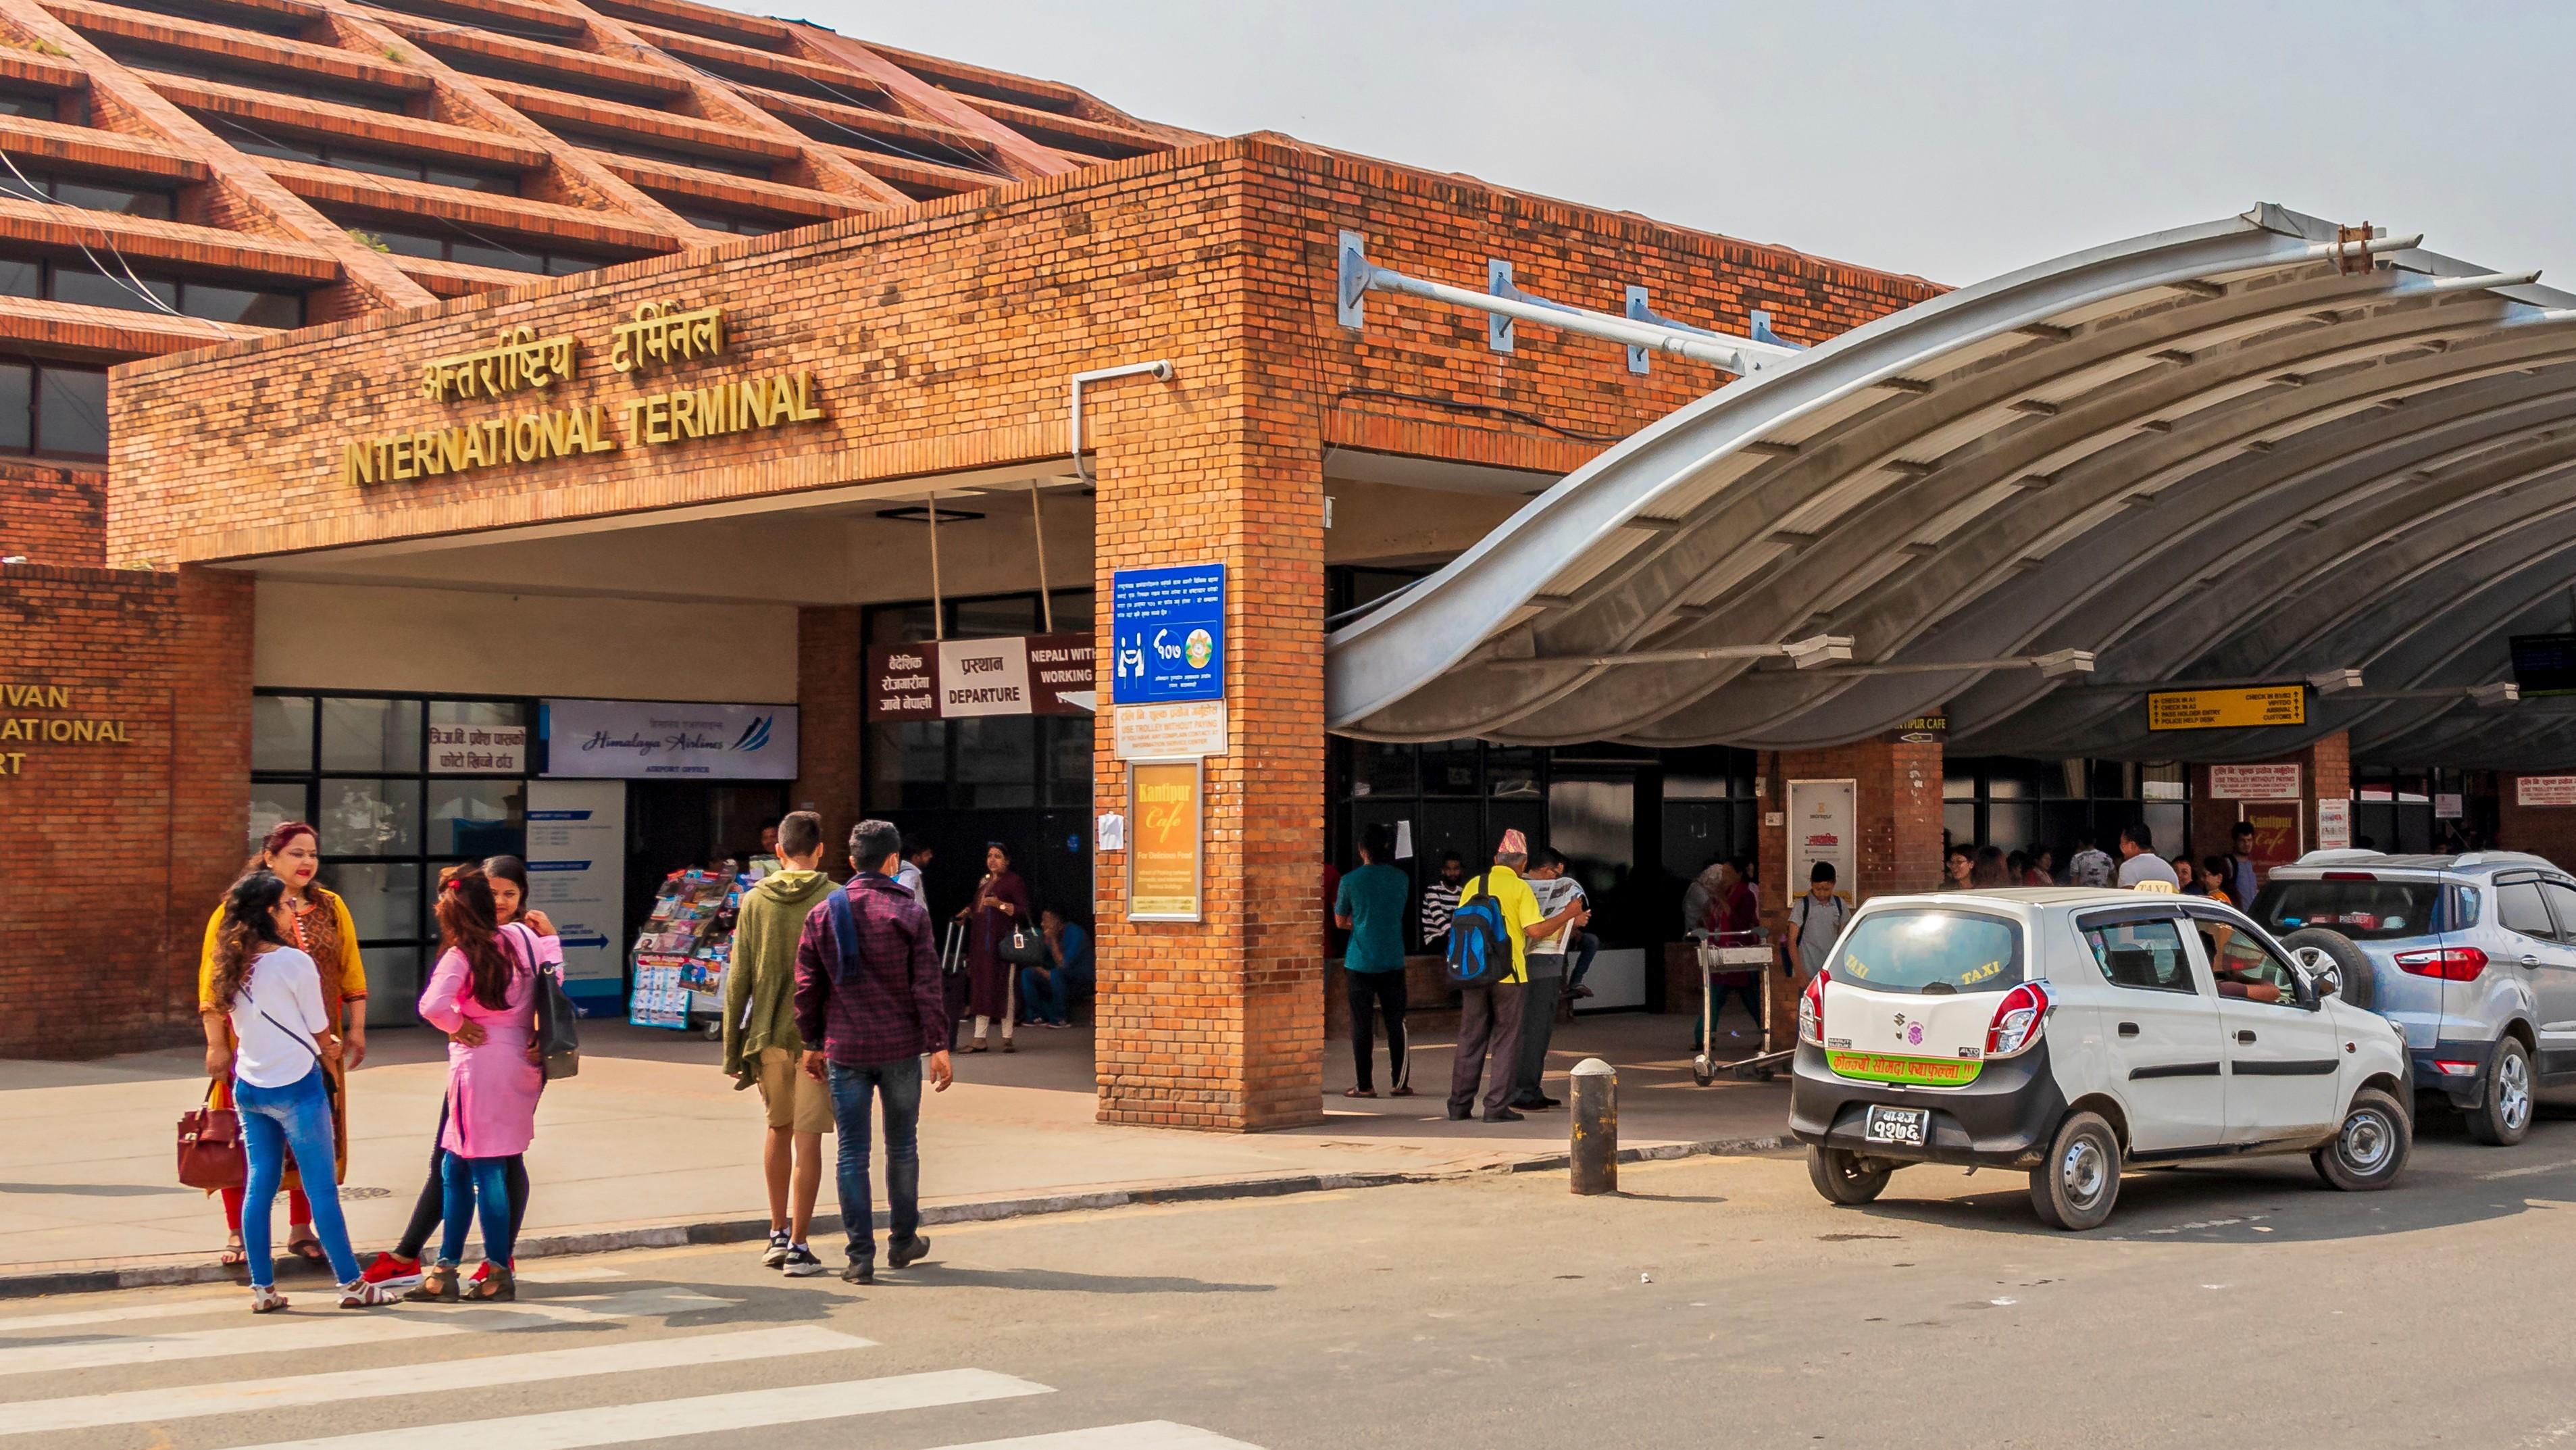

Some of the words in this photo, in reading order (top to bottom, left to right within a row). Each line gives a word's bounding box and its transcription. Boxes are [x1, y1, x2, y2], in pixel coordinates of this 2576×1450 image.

[611, 299, 727, 374] टर्मिनल
[345, 405, 617, 486] INTERNATIONAL
[626, 370, 826, 446] TERMINAL
[1032, 649, 1068, 662] NEPALI
[961, 657, 1003, 675] प्रस्थान
[1041, 670, 1092, 682] WORKING
[949, 686, 1020, 704] DEPARTURE
[1927, 718, 1946, 729] CAFE
[582, 730, 661, 756] Himalaya
[665, 732, 724, 751] Airlines
[1138, 783, 1190, 803] Kantipur
[1146, 802, 1184, 843] Cafe
[2139, 884, 2168, 893] TAXI
[2340, 915, 2369, 924] PREMIER
[1846, 954, 1869, 978] TAXI
[1961, 961, 2000, 984] TAXI
